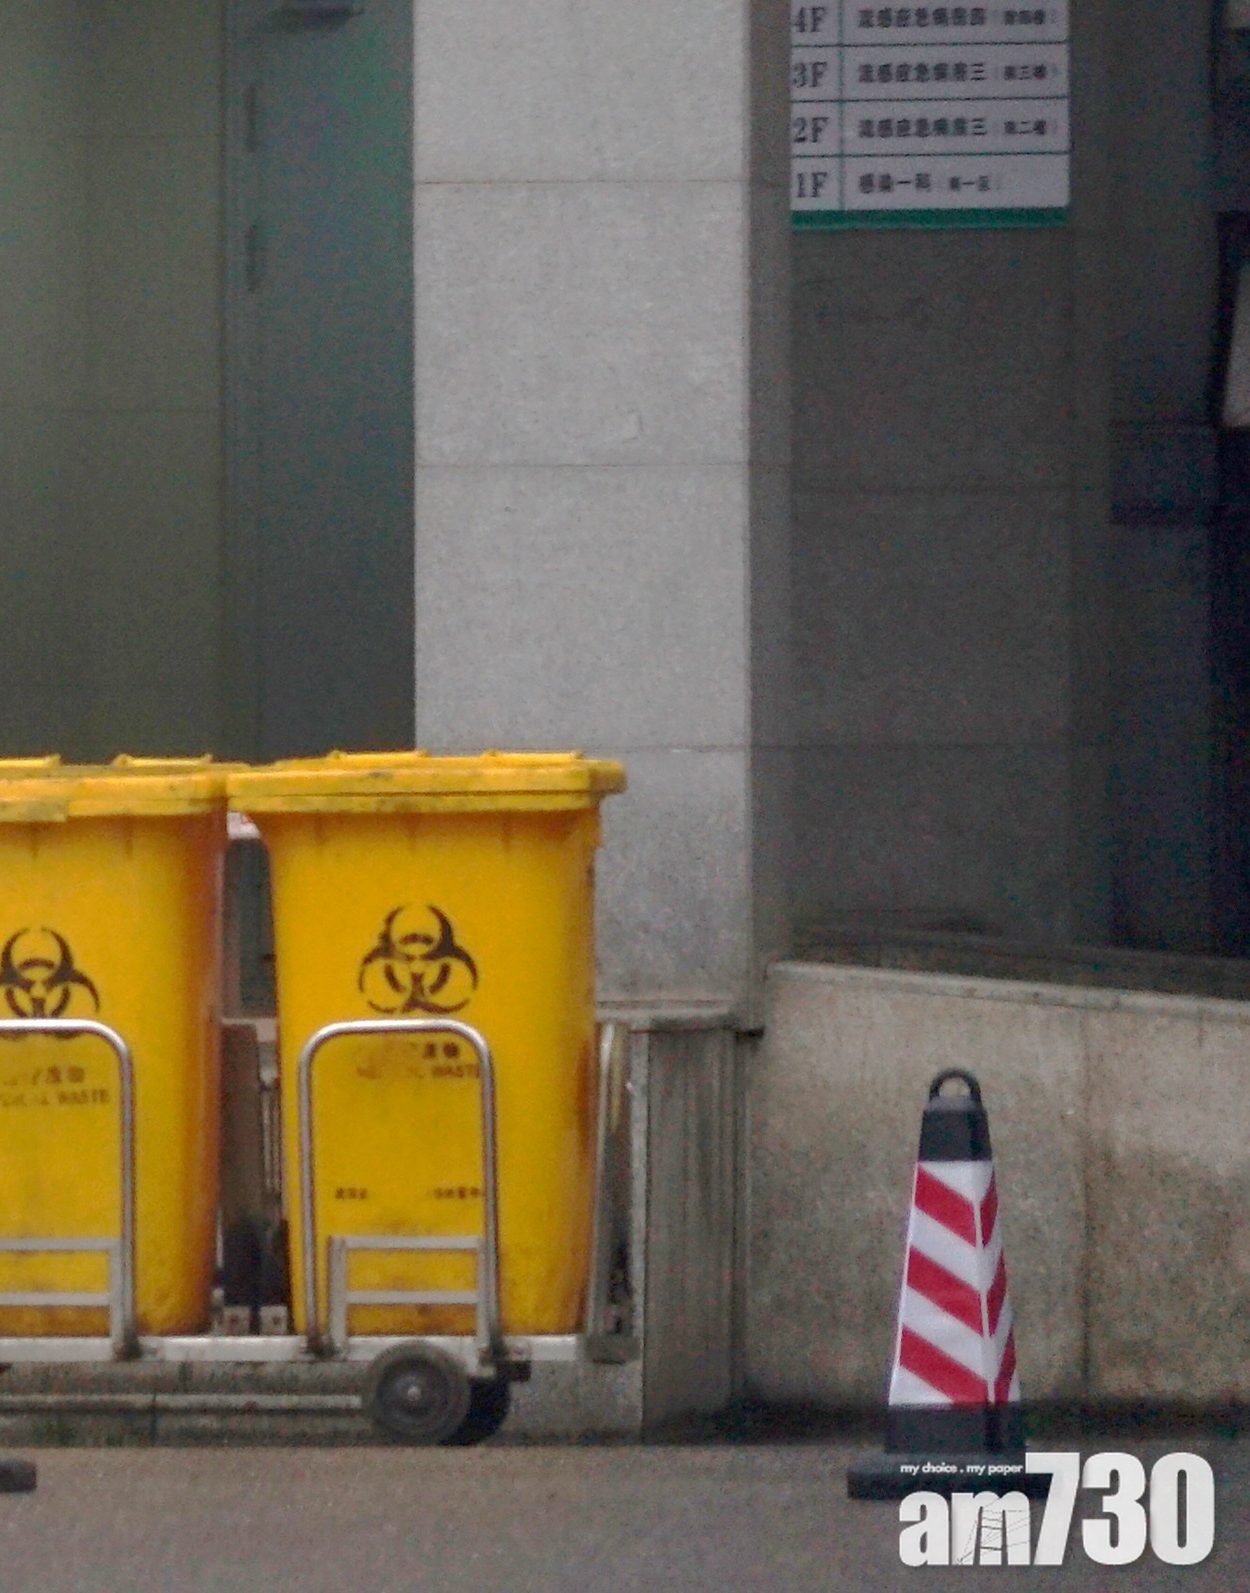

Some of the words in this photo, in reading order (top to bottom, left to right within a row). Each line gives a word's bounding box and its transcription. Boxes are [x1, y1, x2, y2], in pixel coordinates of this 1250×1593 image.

[793, 6, 827, 33] 4F
[792, 61, 828, 88] 3F
[793, 116, 829, 143] 2F
[796, 171, 828, 198] 1F
